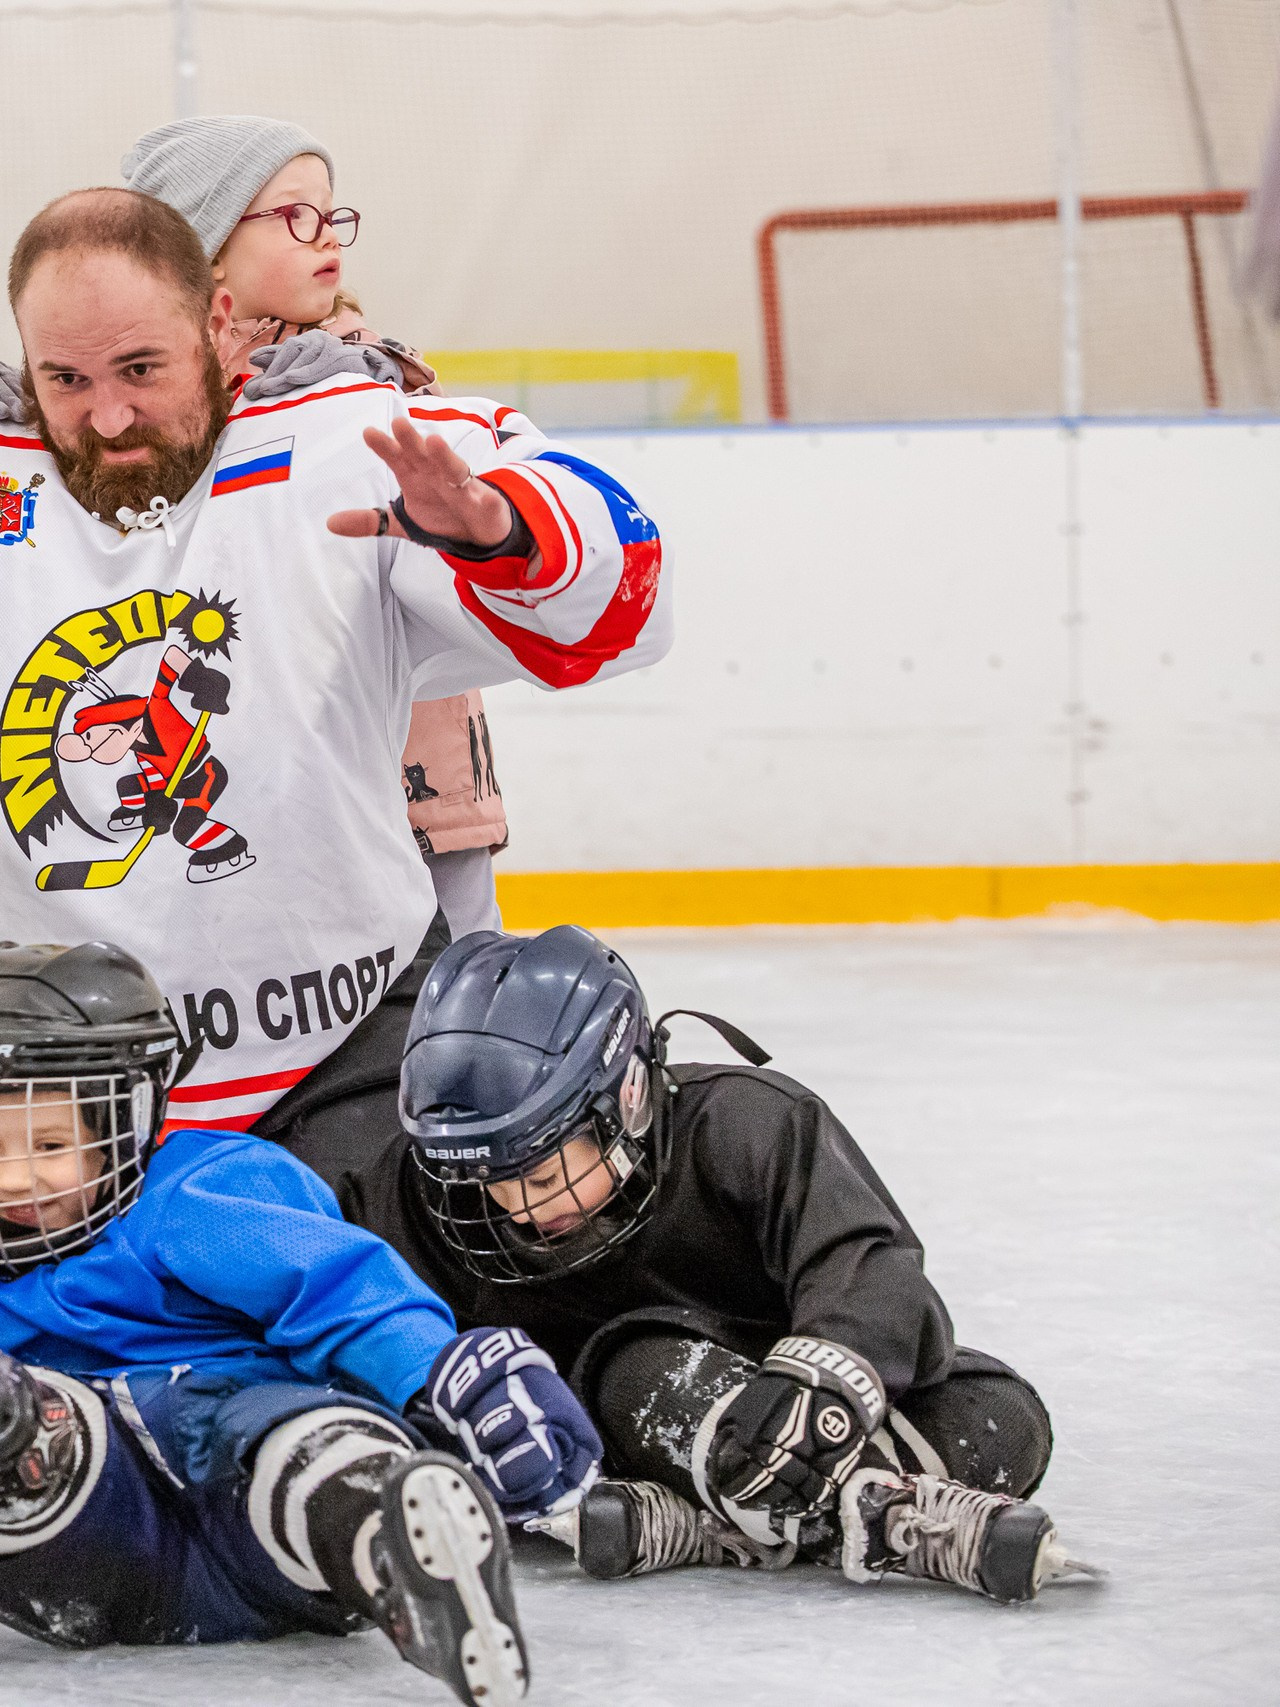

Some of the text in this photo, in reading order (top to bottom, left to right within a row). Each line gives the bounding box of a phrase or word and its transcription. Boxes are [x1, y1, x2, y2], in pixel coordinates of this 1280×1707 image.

[256, 946, 395, 1040] СПОРТ
[425, 1146, 491, 1160] BAUER
[448, 1328, 538, 1408] BAU
[769, 1337, 883, 1418] ARRIOR
